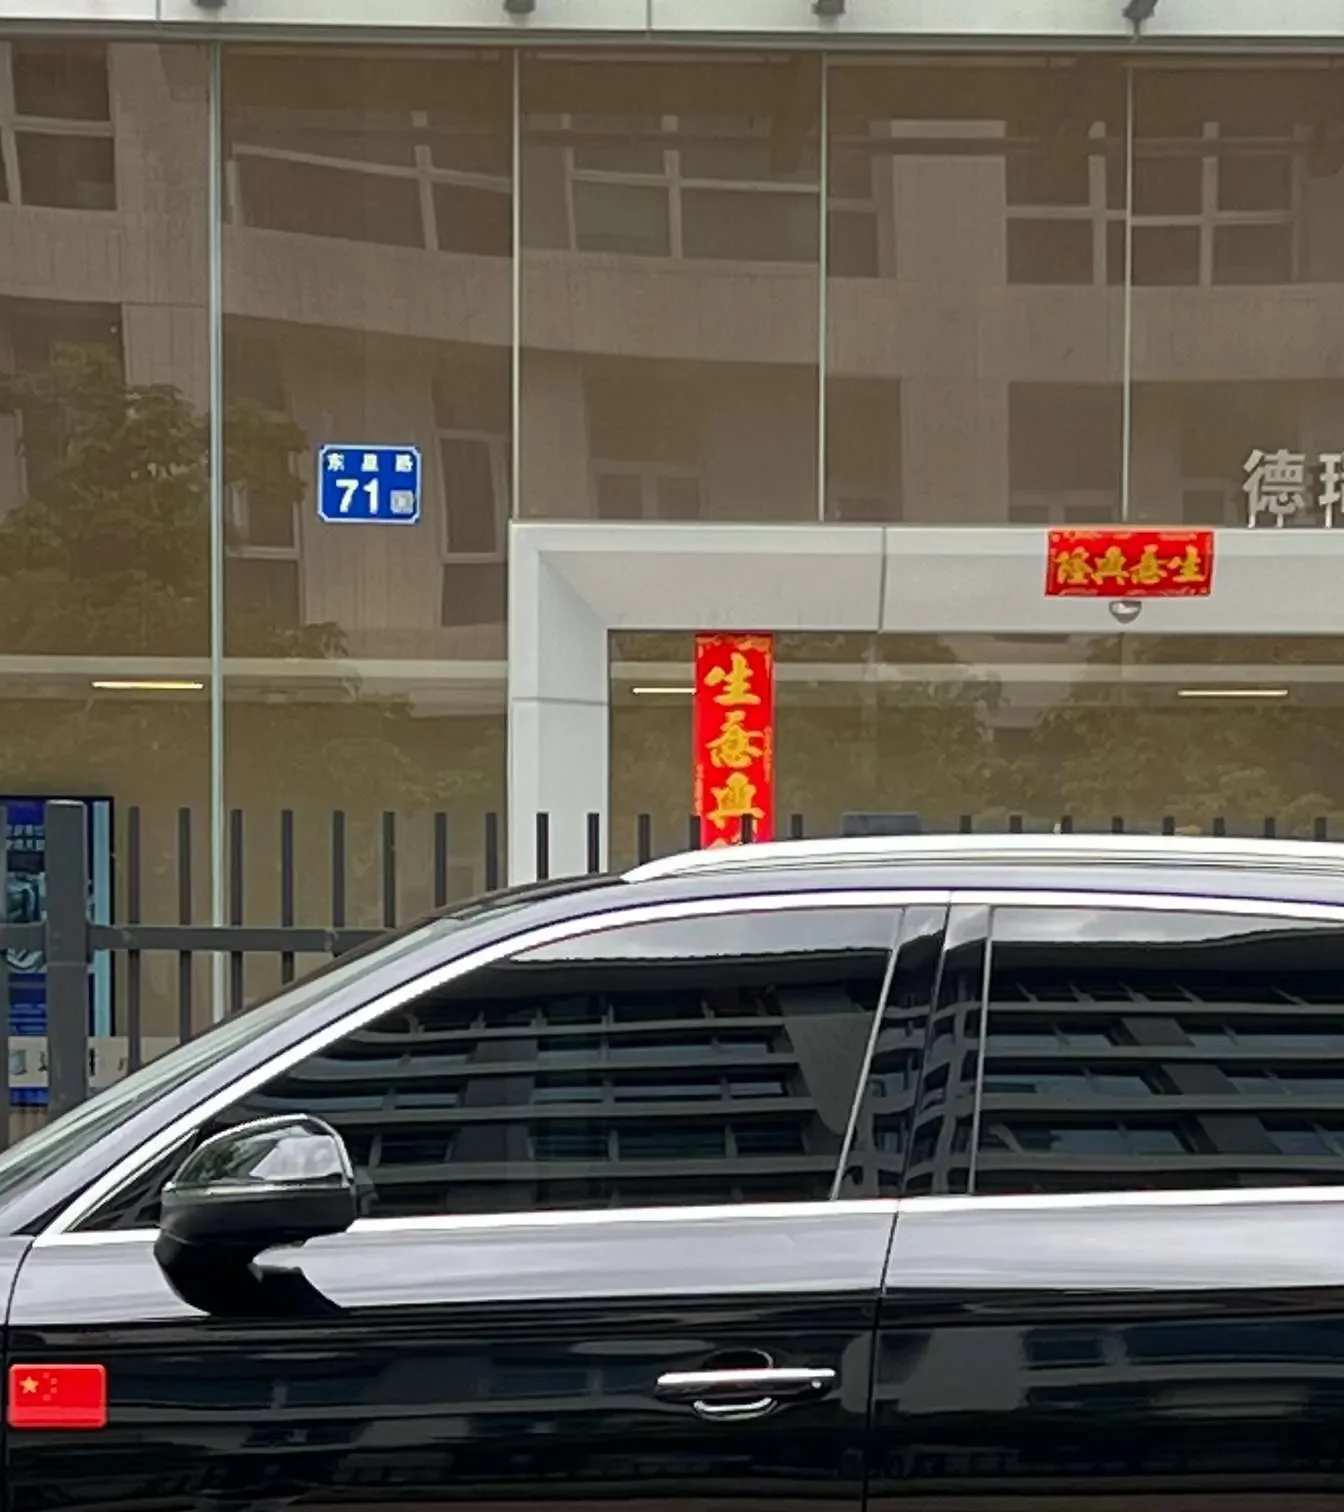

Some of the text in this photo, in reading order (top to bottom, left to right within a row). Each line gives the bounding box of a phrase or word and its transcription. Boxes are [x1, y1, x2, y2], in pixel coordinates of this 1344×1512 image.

[336, 478, 379, 514] 71
[704, 652, 766, 848] 生意興
